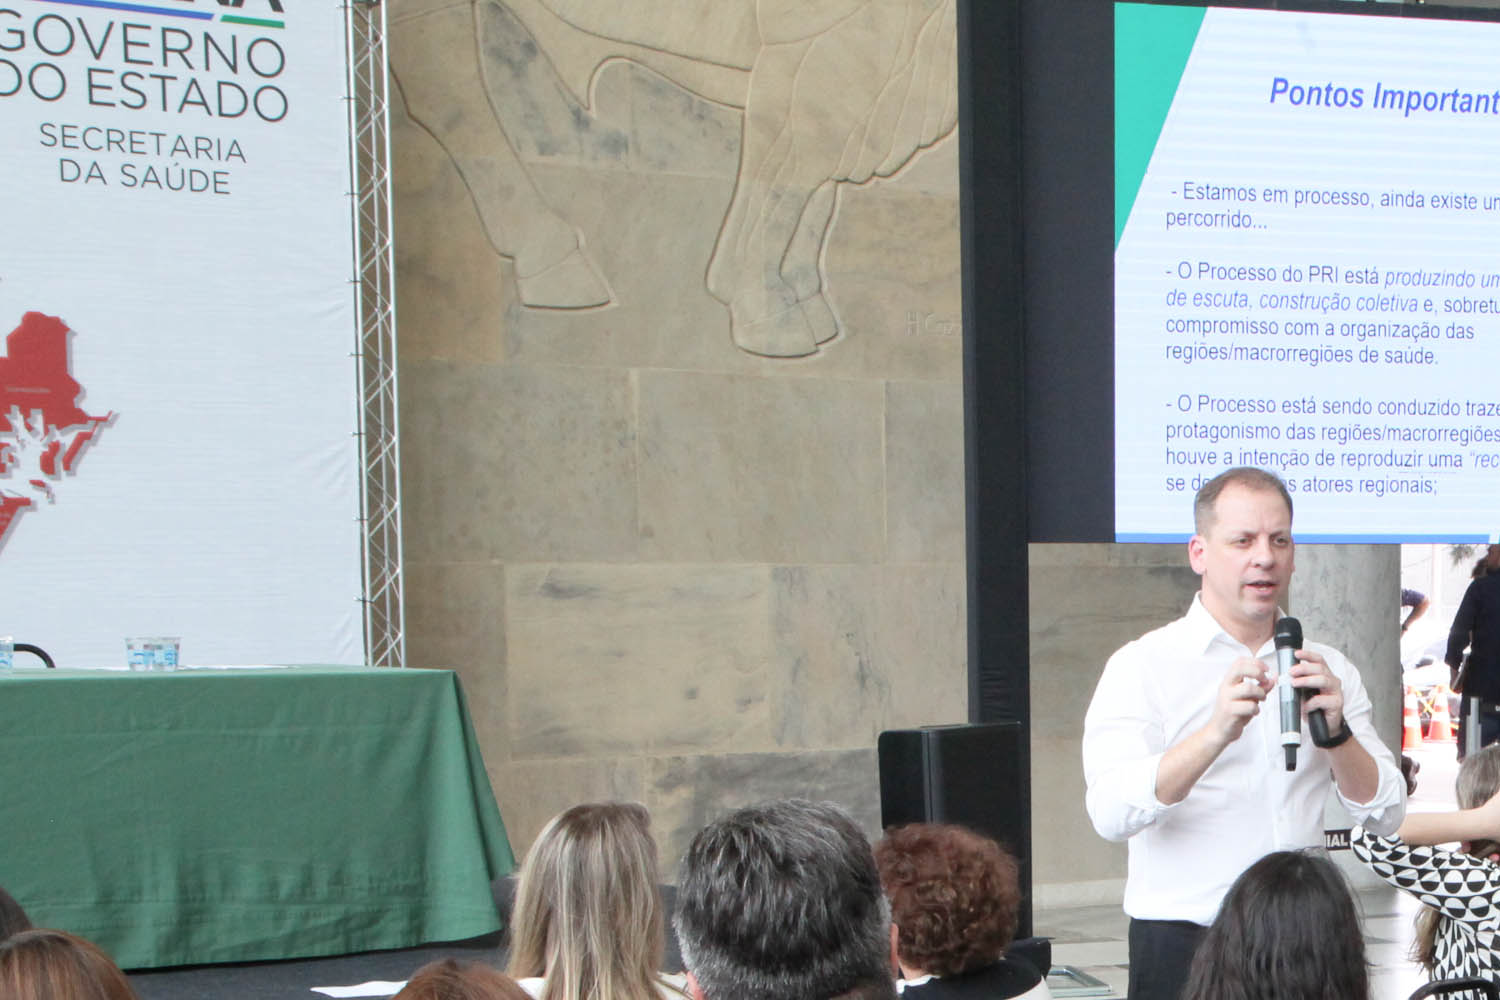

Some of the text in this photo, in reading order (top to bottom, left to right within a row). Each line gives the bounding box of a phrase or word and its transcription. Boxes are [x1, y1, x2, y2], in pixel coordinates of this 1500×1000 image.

[0, 9, 285, 78] GOVERNO
[87, 67, 288, 122] ESTADO
[1269, 77, 1364, 108] Pontos
[39, 122, 246, 163] SECRETARIA
[60, 158, 230, 194] DA SAÚDE
[1183, 181, 1256, 201] Estamos
[1262, 188, 1288, 203] em
[1294, 190, 1374, 208] processo,
[1379, 190, 1424, 208] ainda
[1430, 192, 1477, 209] existe
[1166, 209, 1267, 230] percorrido...
[1177, 262, 1192, 279] O
[1198, 263, 1276, 281] Processo
[1281, 265, 1302, 282] do
[1308, 265, 1338, 283] PRI
[1344, 266, 1379, 284] está
[1383, 270, 1475, 288] produzindo
[1165, 289, 1187, 306] de
[1192, 290, 1252, 308] escuta,
[1259, 292, 1351, 314] construção
[1355, 294, 1418, 312] coletiva
[1423, 299, 1437, 312] e,
[1165, 317, 1474, 343] compromisso com a organização das
[1165, 342, 1438, 367] regiões/macrorregiões de saúde.
[1177, 394, 1192, 412] O
[1197, 394, 1276, 413] Processo
[1281, 396, 1316, 414] está
[1322, 398, 1372, 414] sendo
[1377, 399, 1460, 416] conduzido
[1166, 422, 1280, 443] protagonismo
[1285, 422, 1315, 440] das
[1166, 447, 1217, 465] houve
[1223, 451, 1233, 465] a
[1239, 447, 1309, 471] intenção
[1315, 448, 1335, 466] de
[1341, 449, 1423, 471] reproduzir
[1429, 454, 1463, 467] uma
[1166, 477, 1185, 492] se
[1302, 476, 1353, 493] atores
[1360, 475, 1437, 497] regionais;
